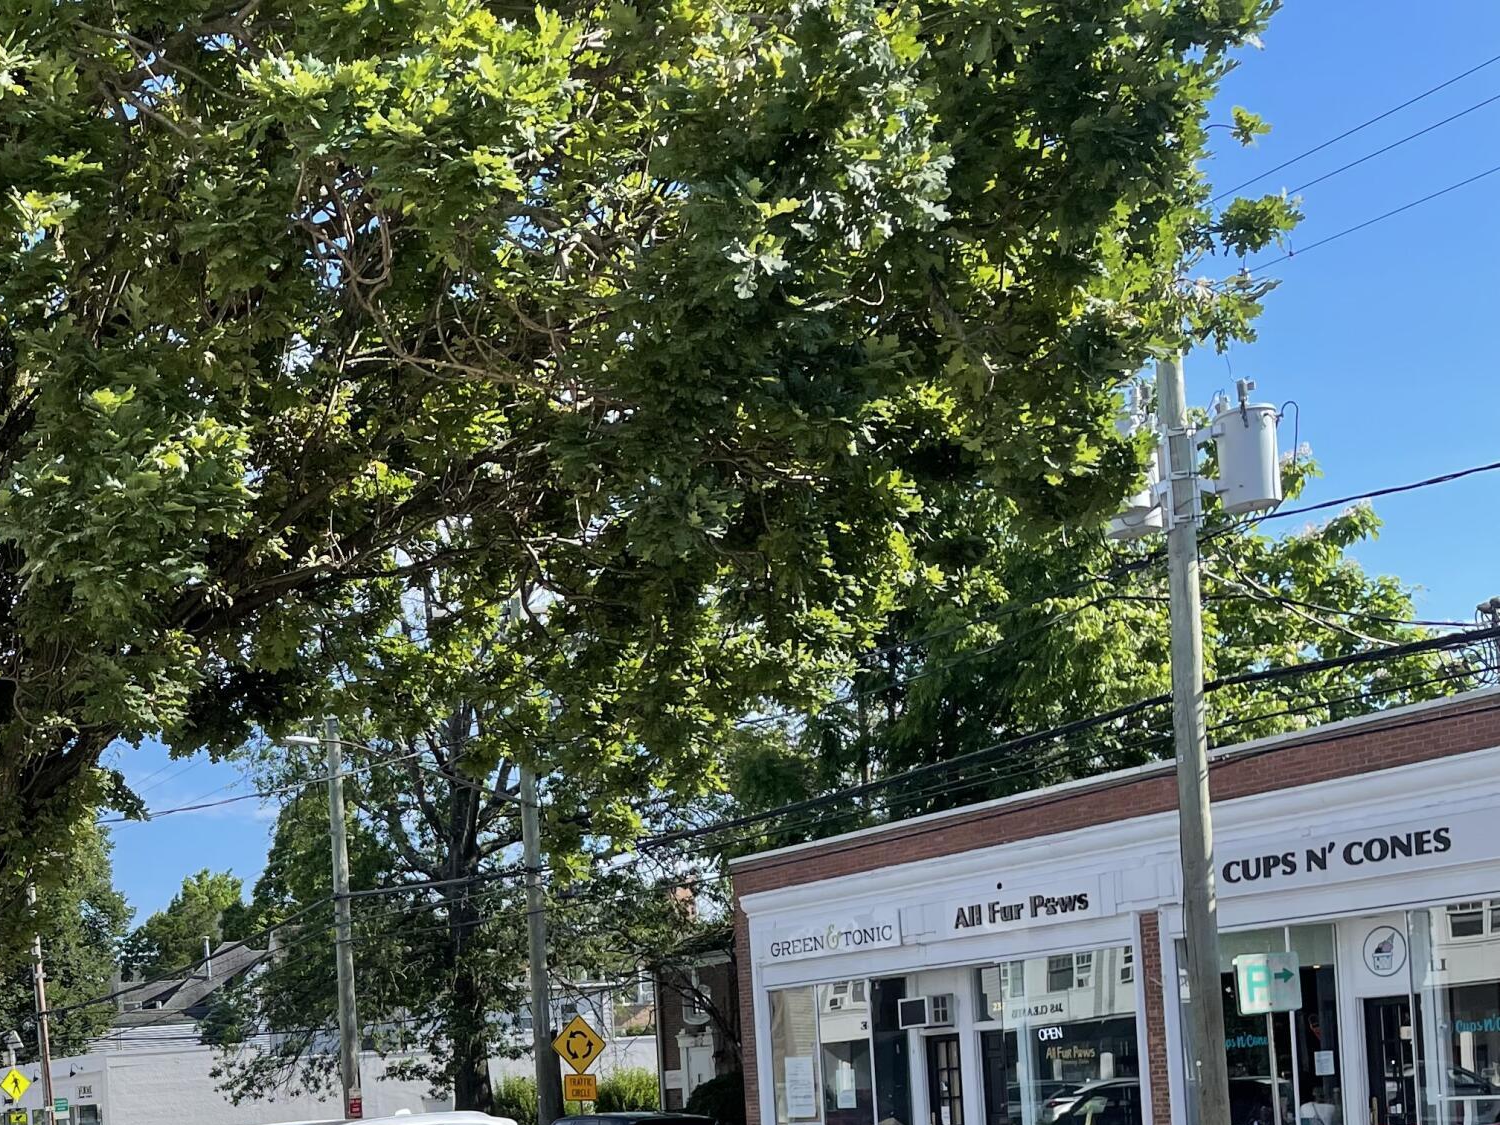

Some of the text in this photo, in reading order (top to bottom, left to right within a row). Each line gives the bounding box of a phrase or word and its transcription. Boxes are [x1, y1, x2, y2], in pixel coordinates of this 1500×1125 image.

[1222, 852, 1297, 883] CUPS
[1342, 827, 1452, 866] CONES
[954, 904, 982, 929] All
[988, 901, 1024, 924] Fur
[1246, 965, 1272, 1003] P
[1038, 1026, 1063, 1041] OPEN
